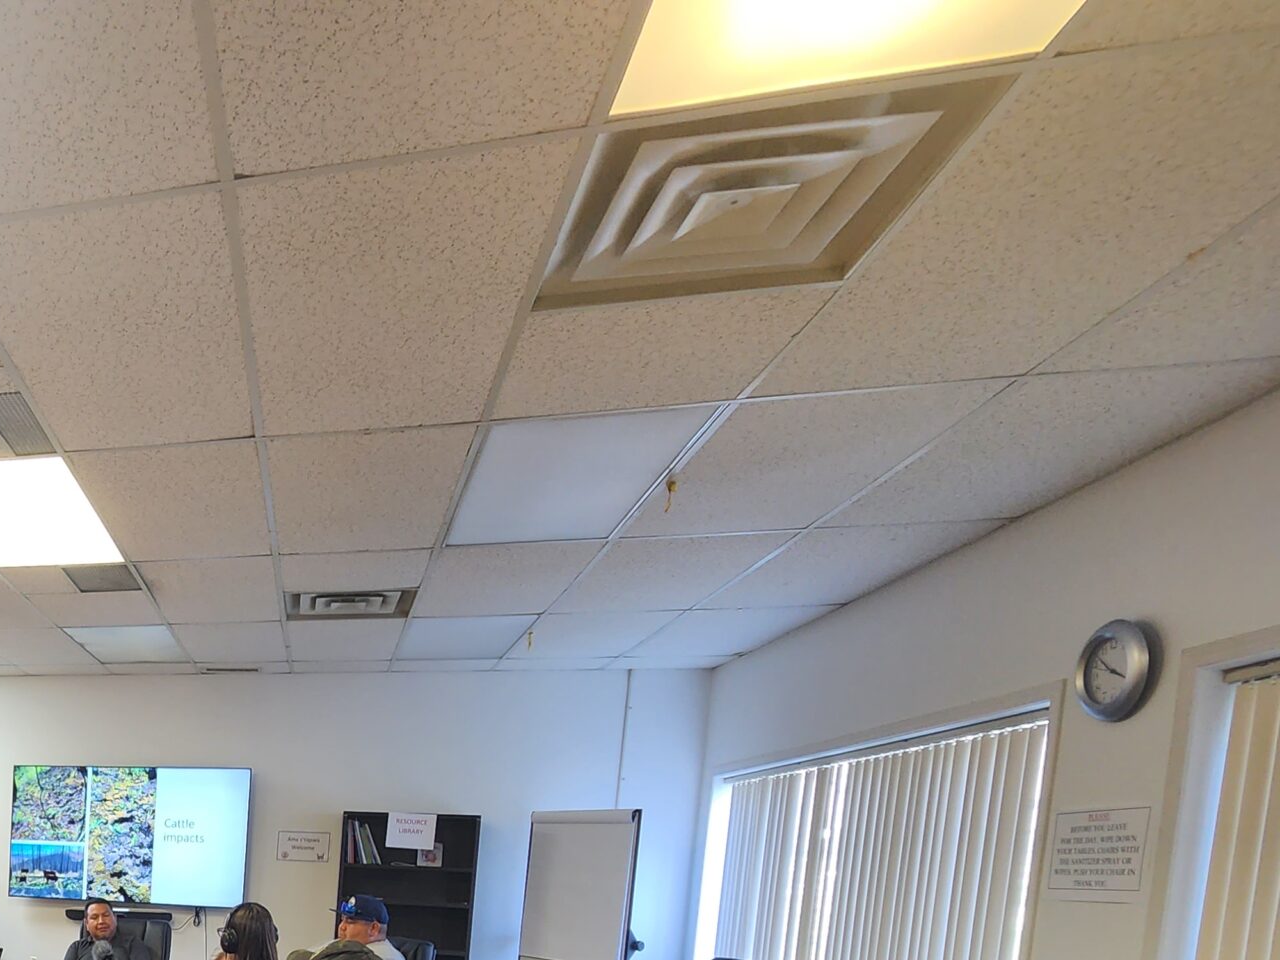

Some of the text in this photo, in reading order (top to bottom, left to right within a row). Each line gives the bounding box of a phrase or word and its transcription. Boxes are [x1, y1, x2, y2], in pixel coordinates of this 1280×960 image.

[164, 818, 195, 829] Cattle
[1070, 825, 1092, 834] BEFORE
[1107, 823, 1128, 832] LEAVE
[163, 833, 205, 844] impacts
[1060, 837, 1071, 845] FOR
[1115, 835, 1138, 843] DOWN
[1097, 846, 1119, 854] CHAIRS
[1127, 868, 1136, 876] IN
[1073, 879, 1093, 887] THANK
